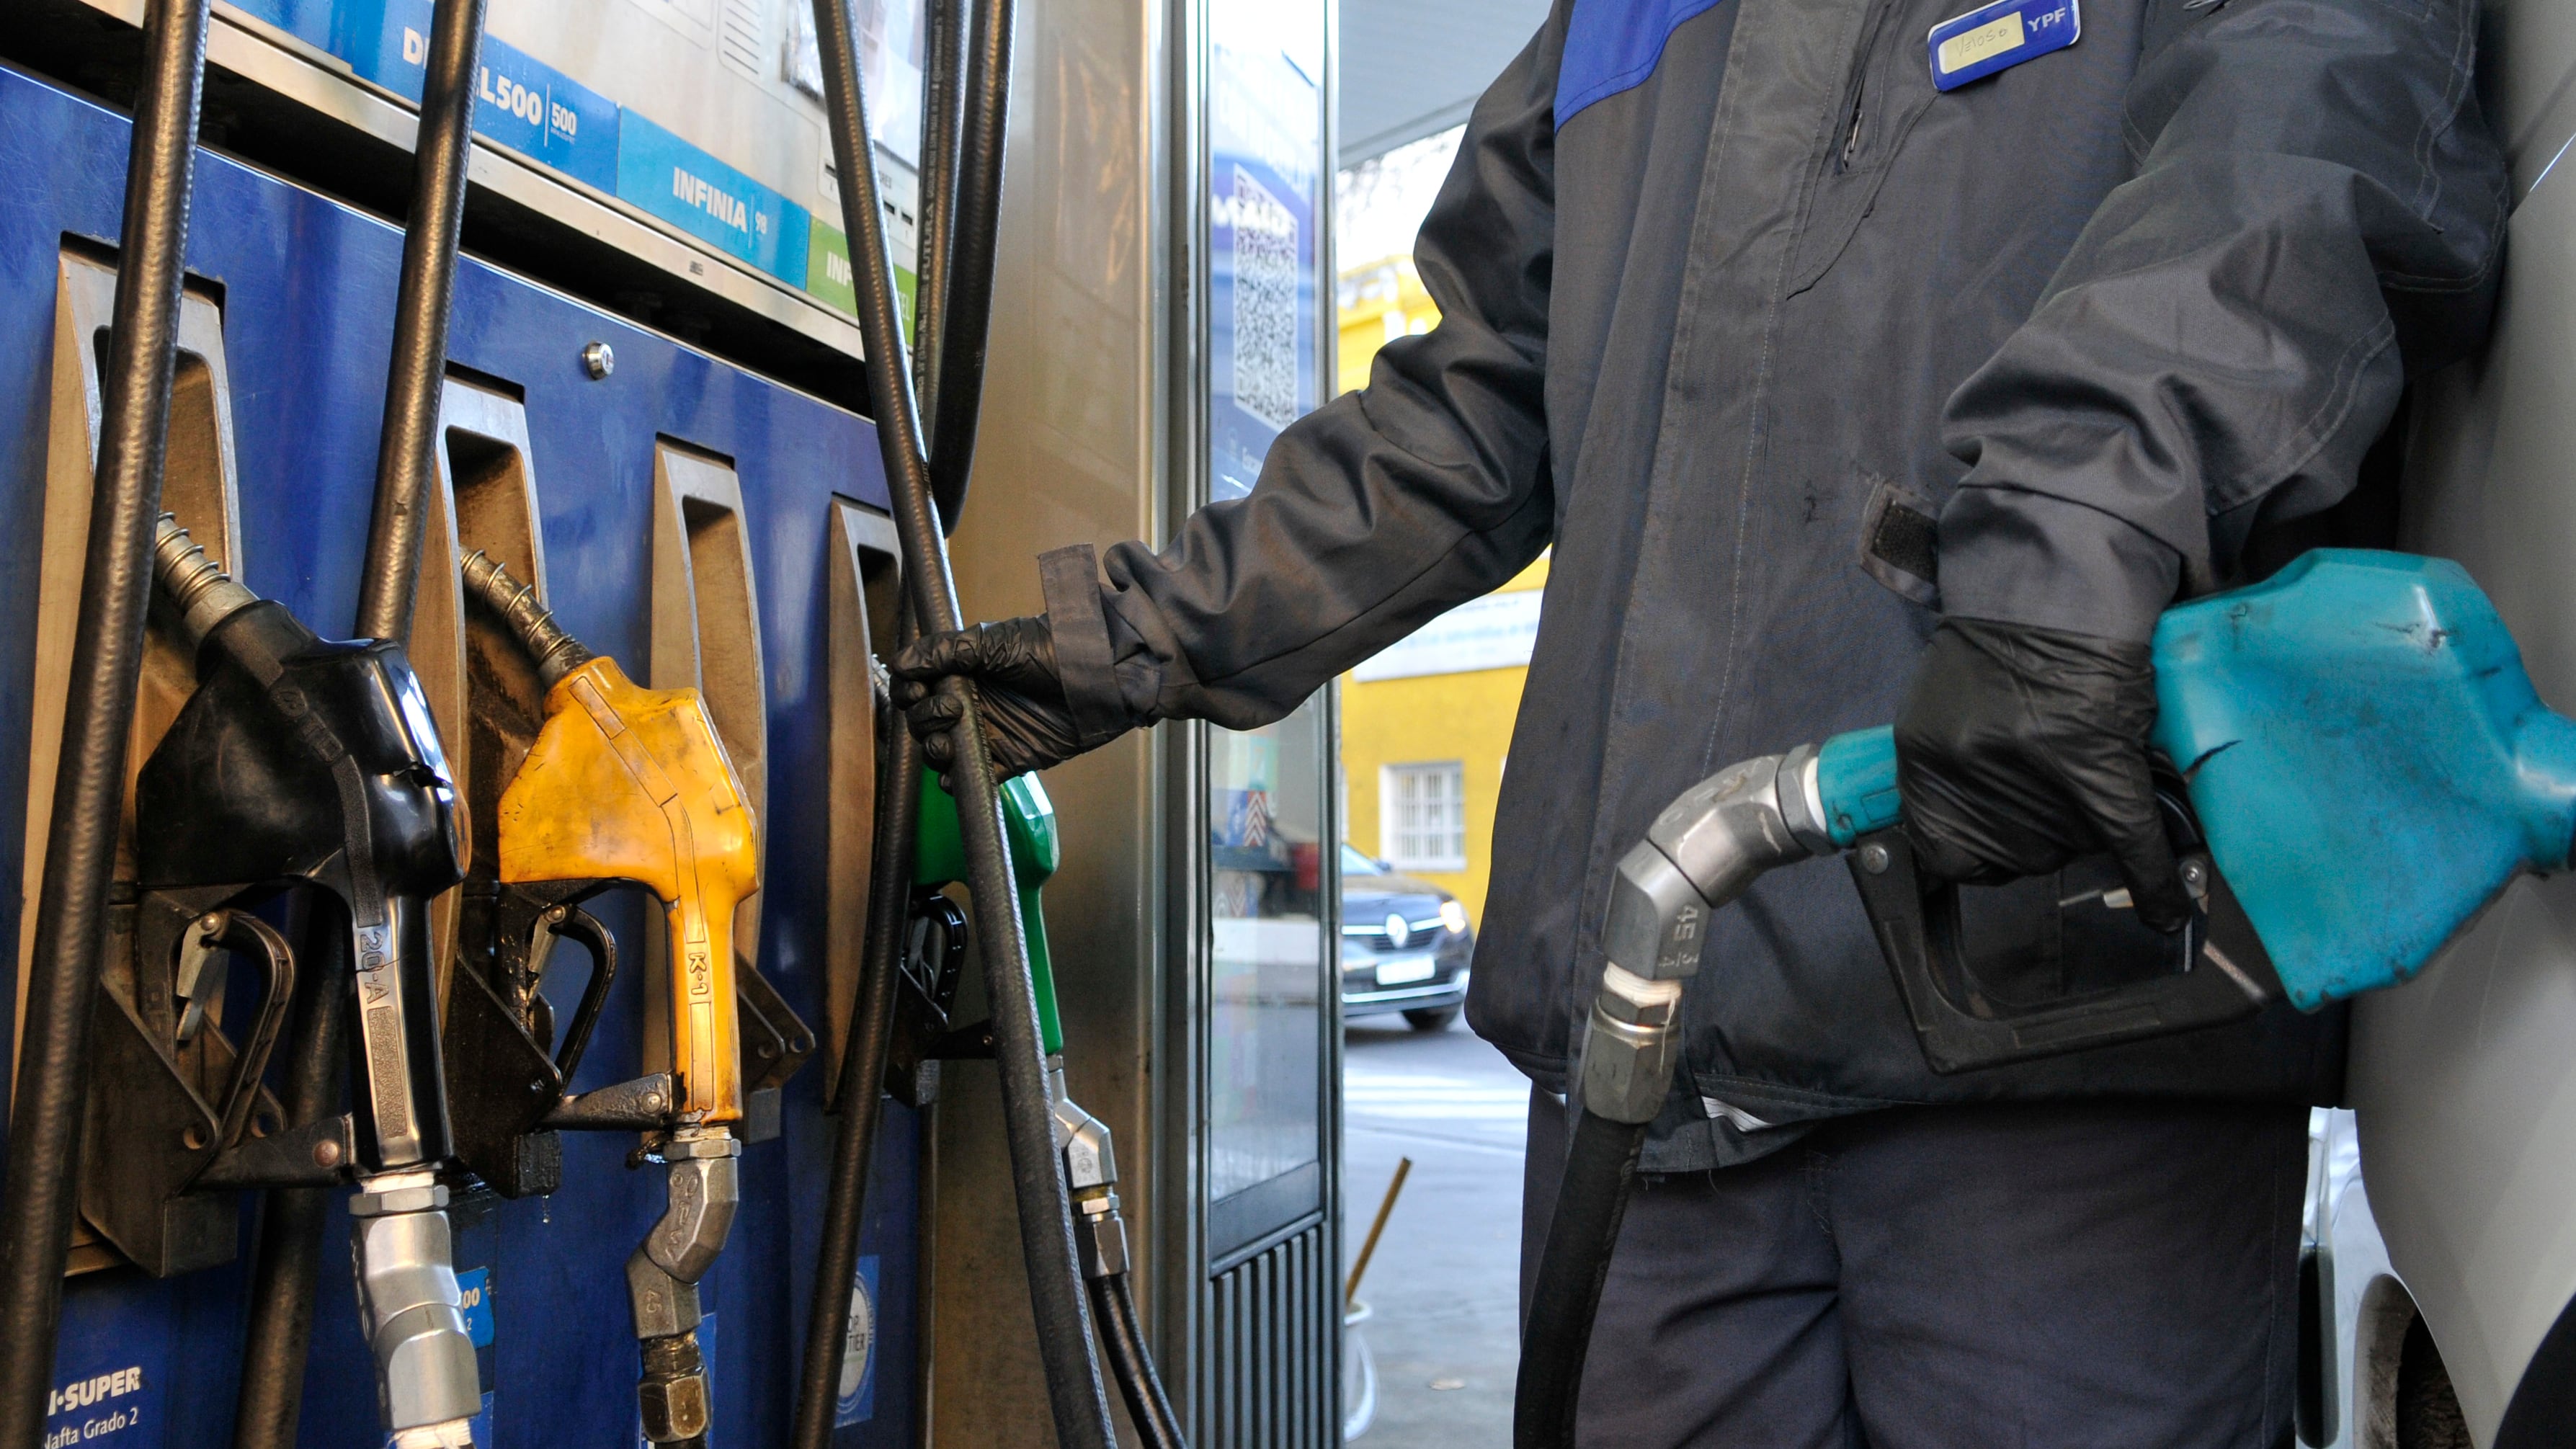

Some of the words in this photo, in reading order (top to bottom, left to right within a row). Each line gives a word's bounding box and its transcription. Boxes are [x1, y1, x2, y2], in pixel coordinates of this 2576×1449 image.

[2028, 7, 2066, 32] YPF
[551, 102, 577, 136] 500
[673, 166, 748, 233] INFINIA
[755, 211, 767, 236] 98
[360, 931, 390, 1004] 20-A
[84, 1411, 125, 1440] Grado
[129, 1406, 138, 1426] 2
